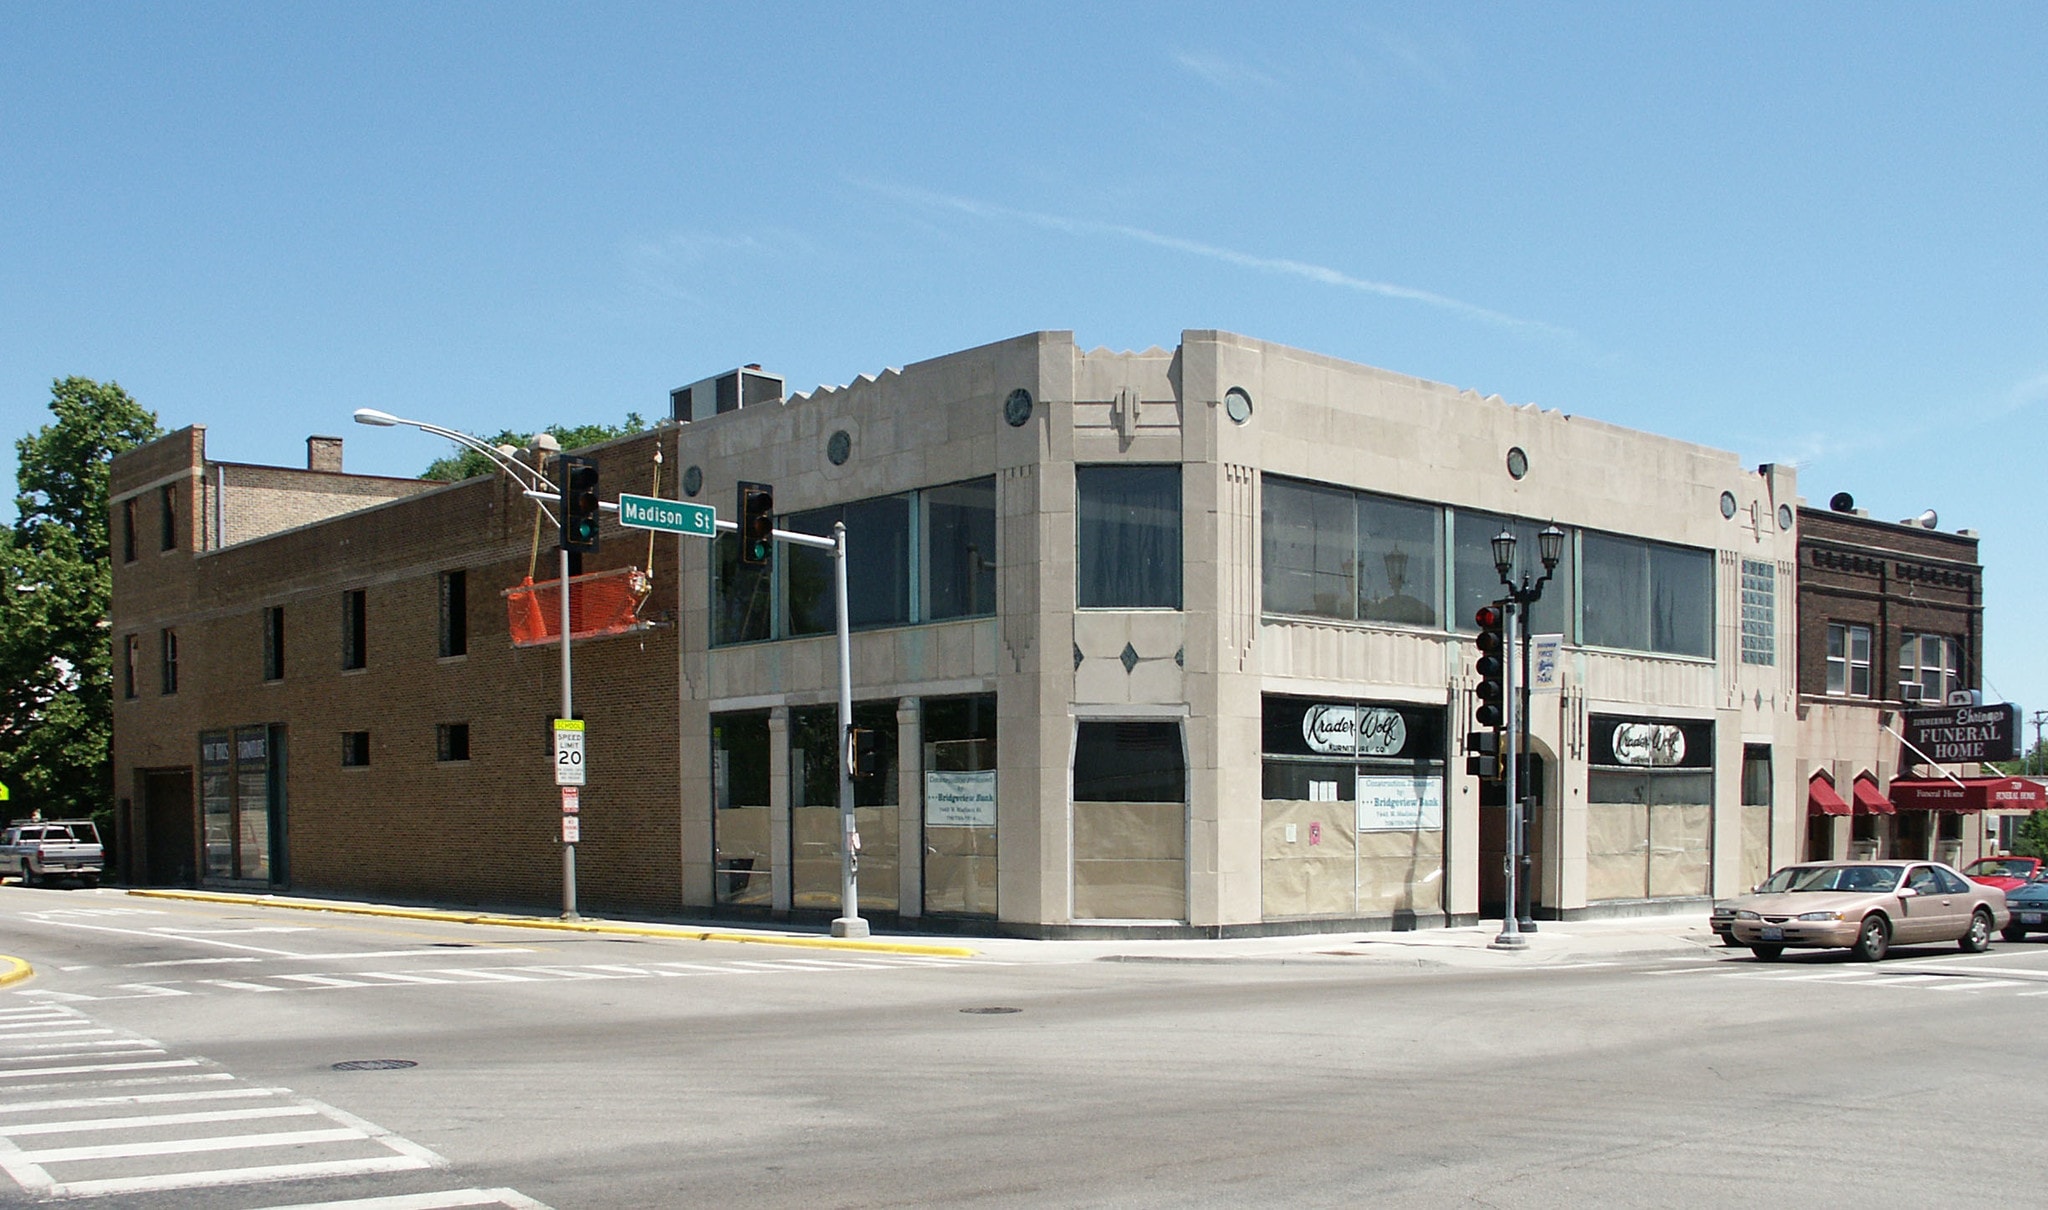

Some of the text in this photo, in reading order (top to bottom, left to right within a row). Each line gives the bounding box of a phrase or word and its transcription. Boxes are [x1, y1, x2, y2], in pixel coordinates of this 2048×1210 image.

[625, 502, 710, 530] Madison St
[1360, 711, 1399, 746] Wolf
[1920, 726, 2001, 743] FUNERAL
[559, 750, 581, 765] 20
[1935, 743, 1984, 758] HOME
[938, 793, 994, 804] Bridgeview Bank
[1916, 789, 1965, 798] Funeral Home
[1374, 797, 1439, 809] Bridgeview Bank
